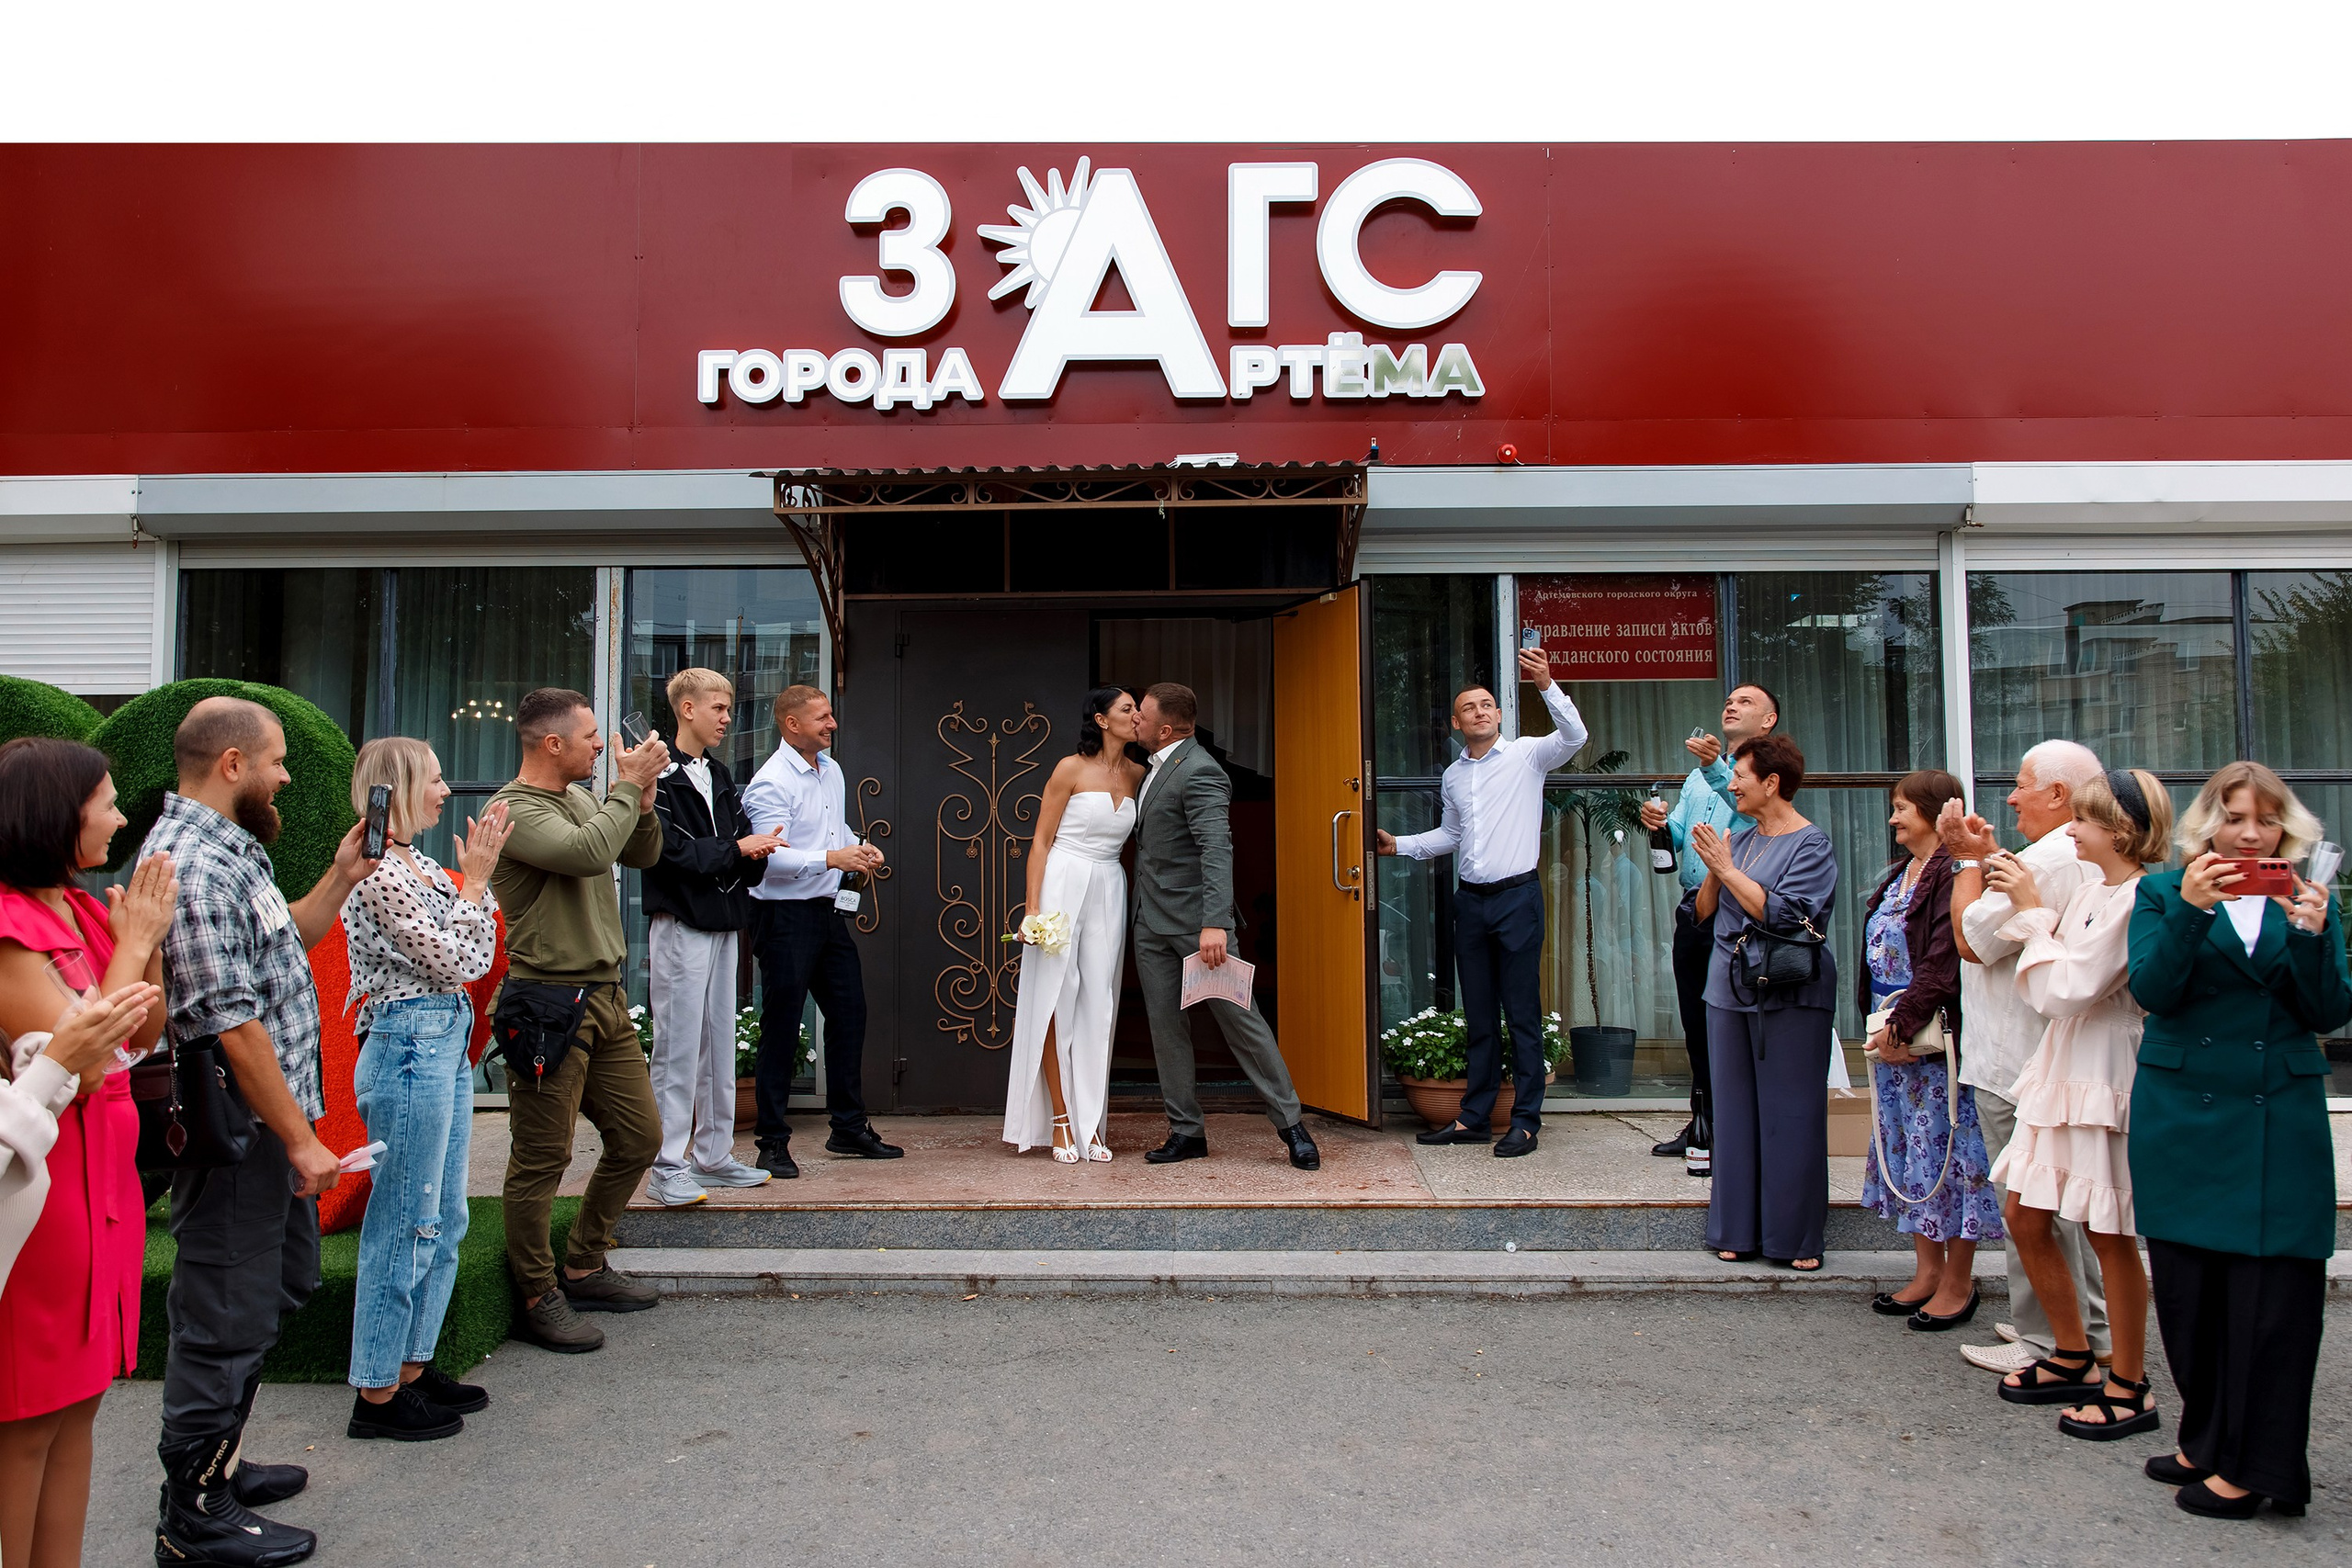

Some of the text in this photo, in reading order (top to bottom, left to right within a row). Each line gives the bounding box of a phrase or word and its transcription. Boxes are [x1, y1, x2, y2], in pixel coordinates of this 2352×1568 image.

[697, 347, 985, 410] ГОРОДА
[1606, 591, 1661, 600] городского
[1664, 591, 1698, 600] округа
[1615, 624, 1667, 637] записи
[1672, 623, 1713, 637] актов
[1549, 649, 1713, 666] жданского состояния
